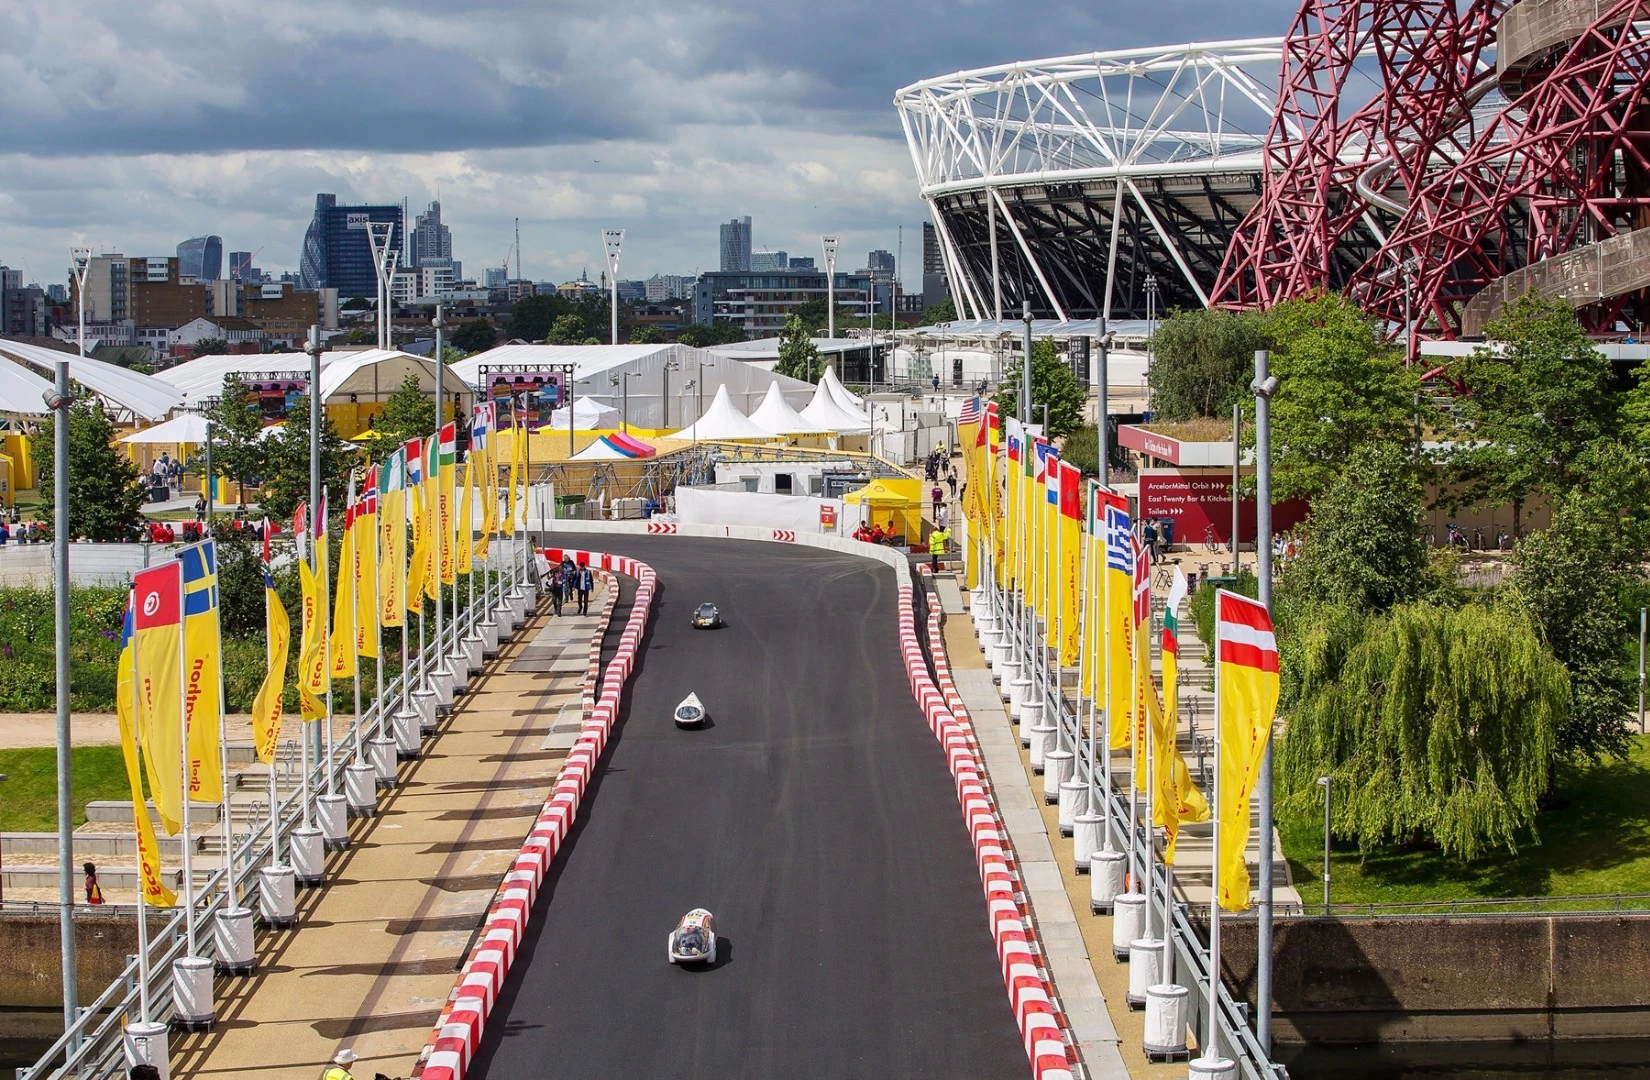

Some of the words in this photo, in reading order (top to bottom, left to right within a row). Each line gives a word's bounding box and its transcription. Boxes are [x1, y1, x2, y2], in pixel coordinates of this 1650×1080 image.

[348, 214, 368, 224] axis
[1148, 482, 1190, 490] ArcelorMittal
[1192, 482, 1209, 490] Orbit
[1163, 495, 1185, 504] Twenty
